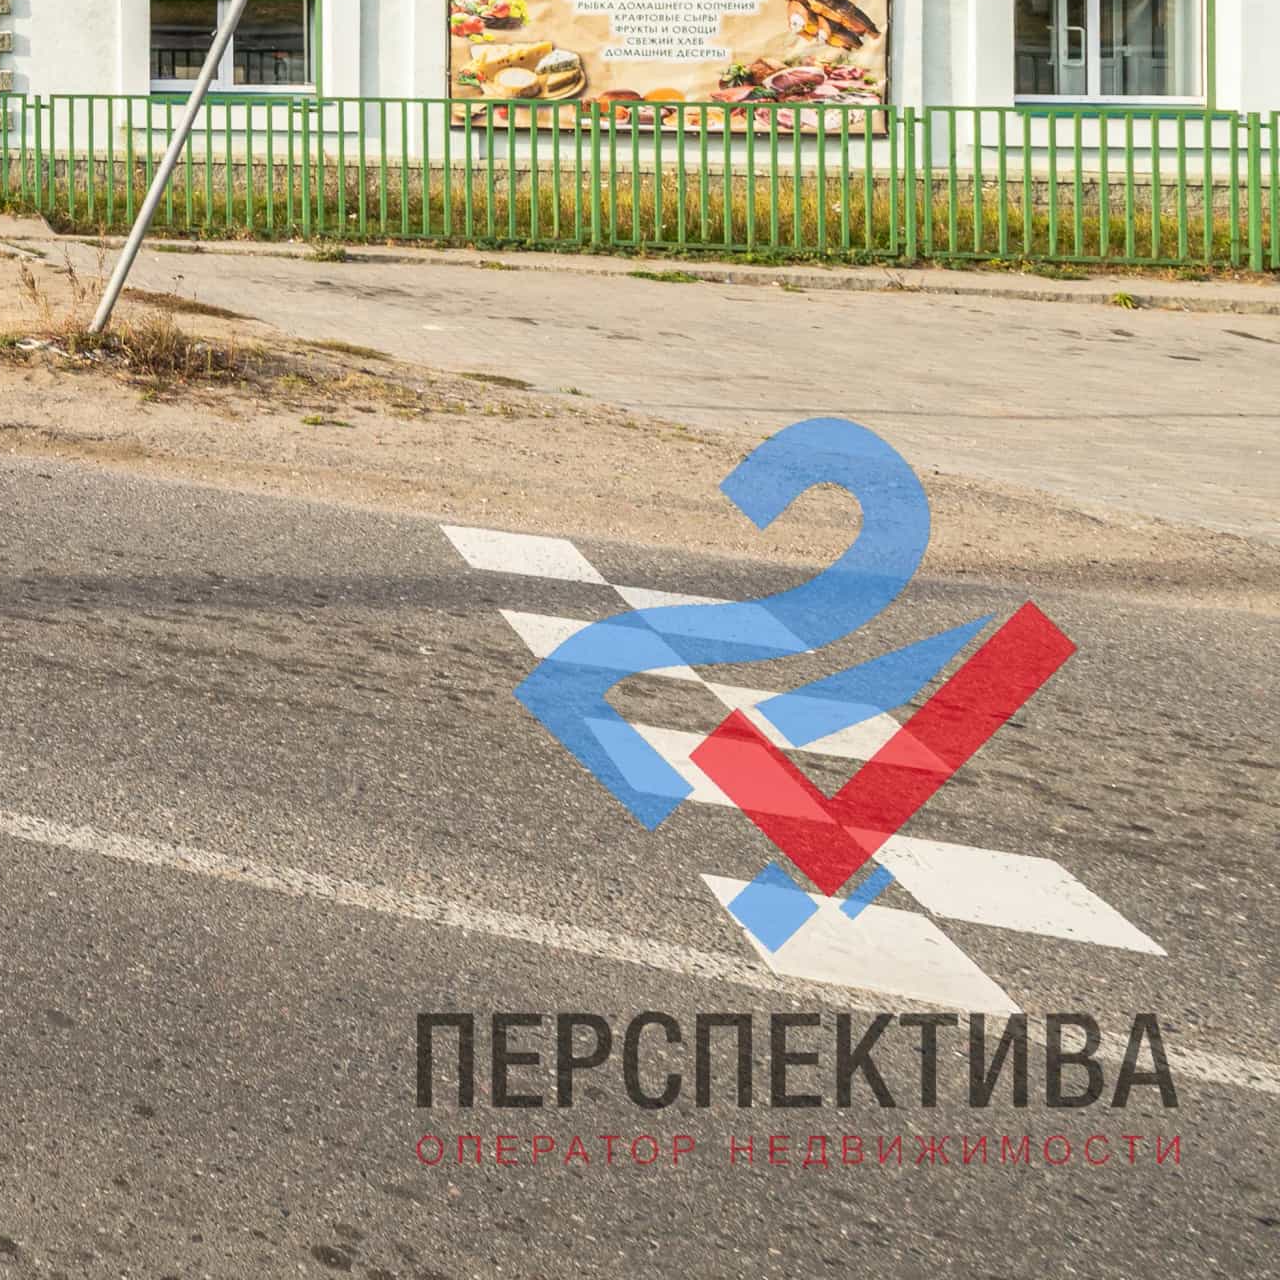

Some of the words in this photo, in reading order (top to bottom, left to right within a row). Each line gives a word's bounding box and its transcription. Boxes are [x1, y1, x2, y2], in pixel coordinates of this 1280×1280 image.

[578, 1, 614, 9] РЫБКА
[618, 1, 693, 10] ДОМАШНЕГО
[697, 1, 755, 10] КОПЧЕНИЯ
[614, 13, 681, 22] КРАФТОВЫЕ
[684, 13, 717, 21] СЫРЫ
[615, 25, 658, 34] ФРУКТЫ
[672, 25, 716, 34] ОВОЩИ
[677, 37, 704, 45] ХЛЕБ
[605, 49, 673, 57] ДОМАШНИЕ
[676, 49, 726, 58] ДЕСЕРТЫ
